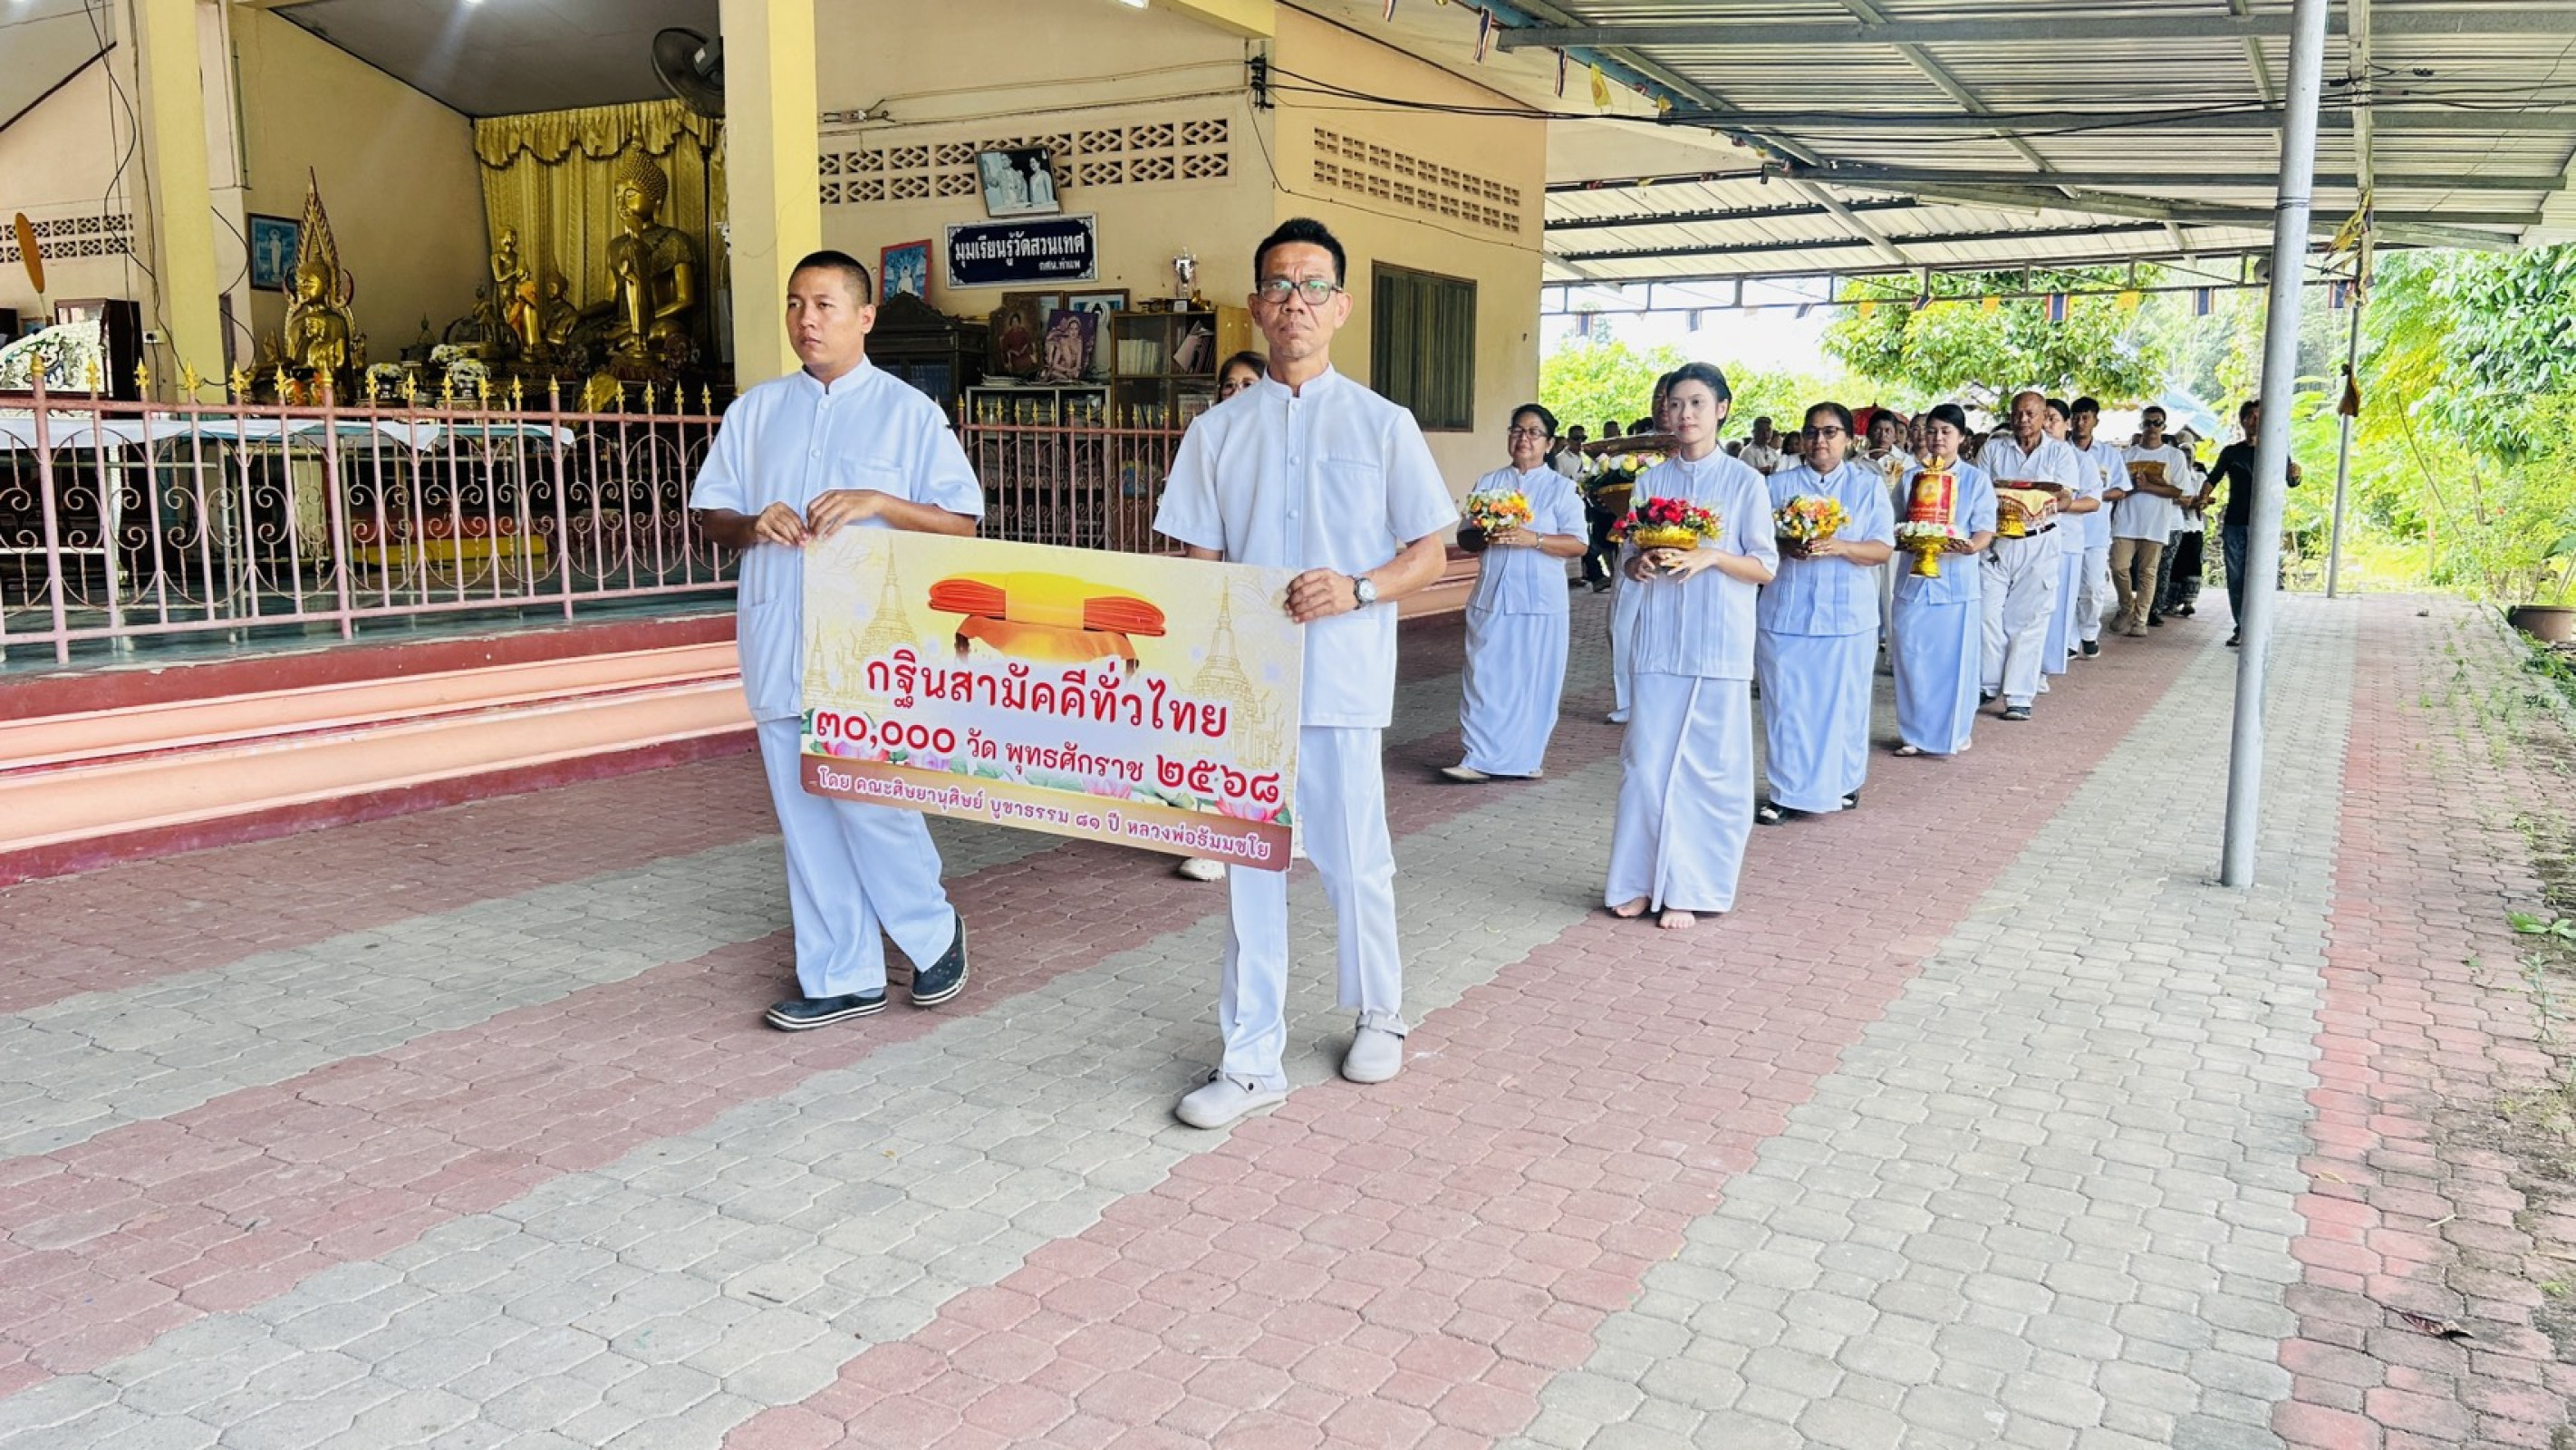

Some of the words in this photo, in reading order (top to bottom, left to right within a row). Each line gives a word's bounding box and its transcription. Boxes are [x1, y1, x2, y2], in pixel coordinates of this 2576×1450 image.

[866, 648, 1227, 738] กฐินสามัคคีทั่วไทย
[816, 710, 957, 754] ๓๐,๐๐๐
[967, 727, 998, 760] วัด
[1005, 740, 1144, 782] พุทธศักราช
[1155, 753, 1280, 804] ๒๕๖๘
[817, 767, 850, 790] โดย
[855, 778, 984, 811] คณะศิษยานุศิษย์
[990, 798, 1069, 824] บูชาธรรม
[1076, 813, 1100, 830] ๘๑
[1107, 811, 1120, 832] ปี
[1127, 821, 1270, 858] หลวงพ่อธัมมชโย
